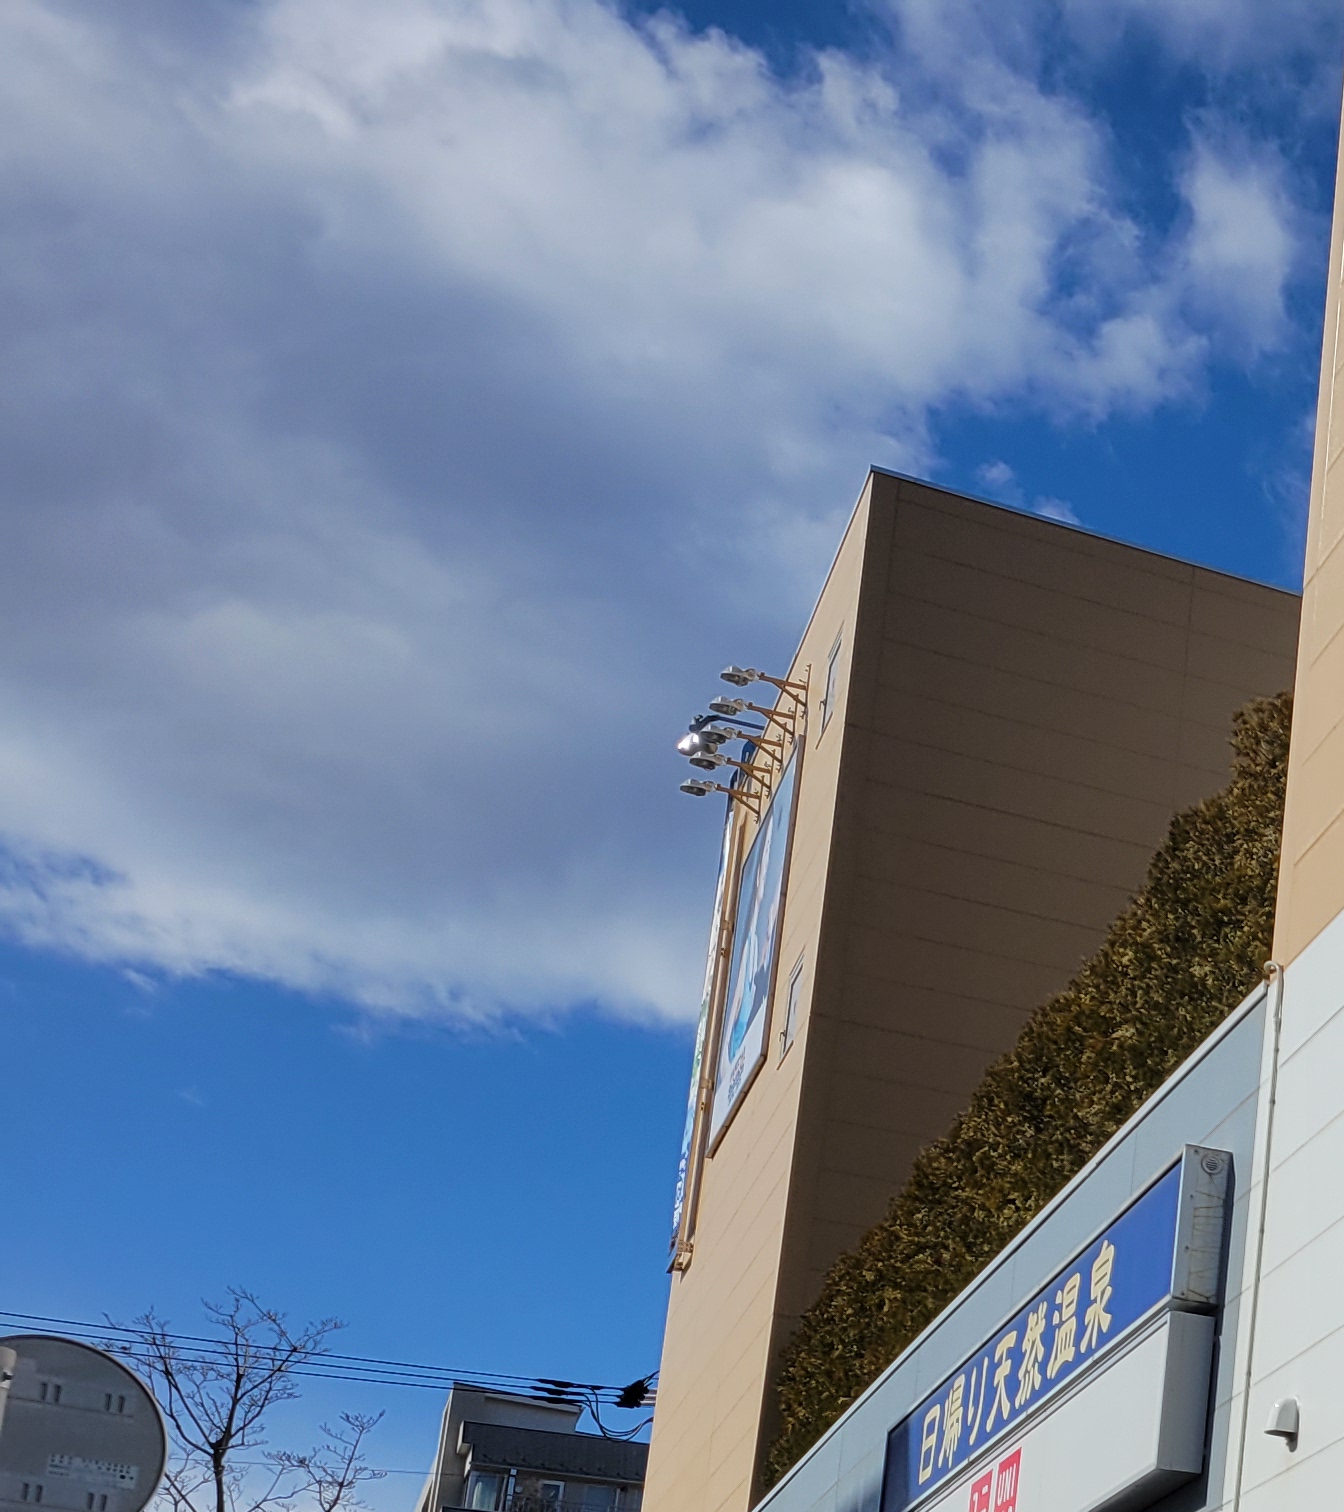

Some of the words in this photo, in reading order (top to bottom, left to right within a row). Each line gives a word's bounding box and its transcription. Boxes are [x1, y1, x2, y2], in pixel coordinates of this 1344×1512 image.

[918, 1239, 1115, 1486] 日帰り天然温泉
